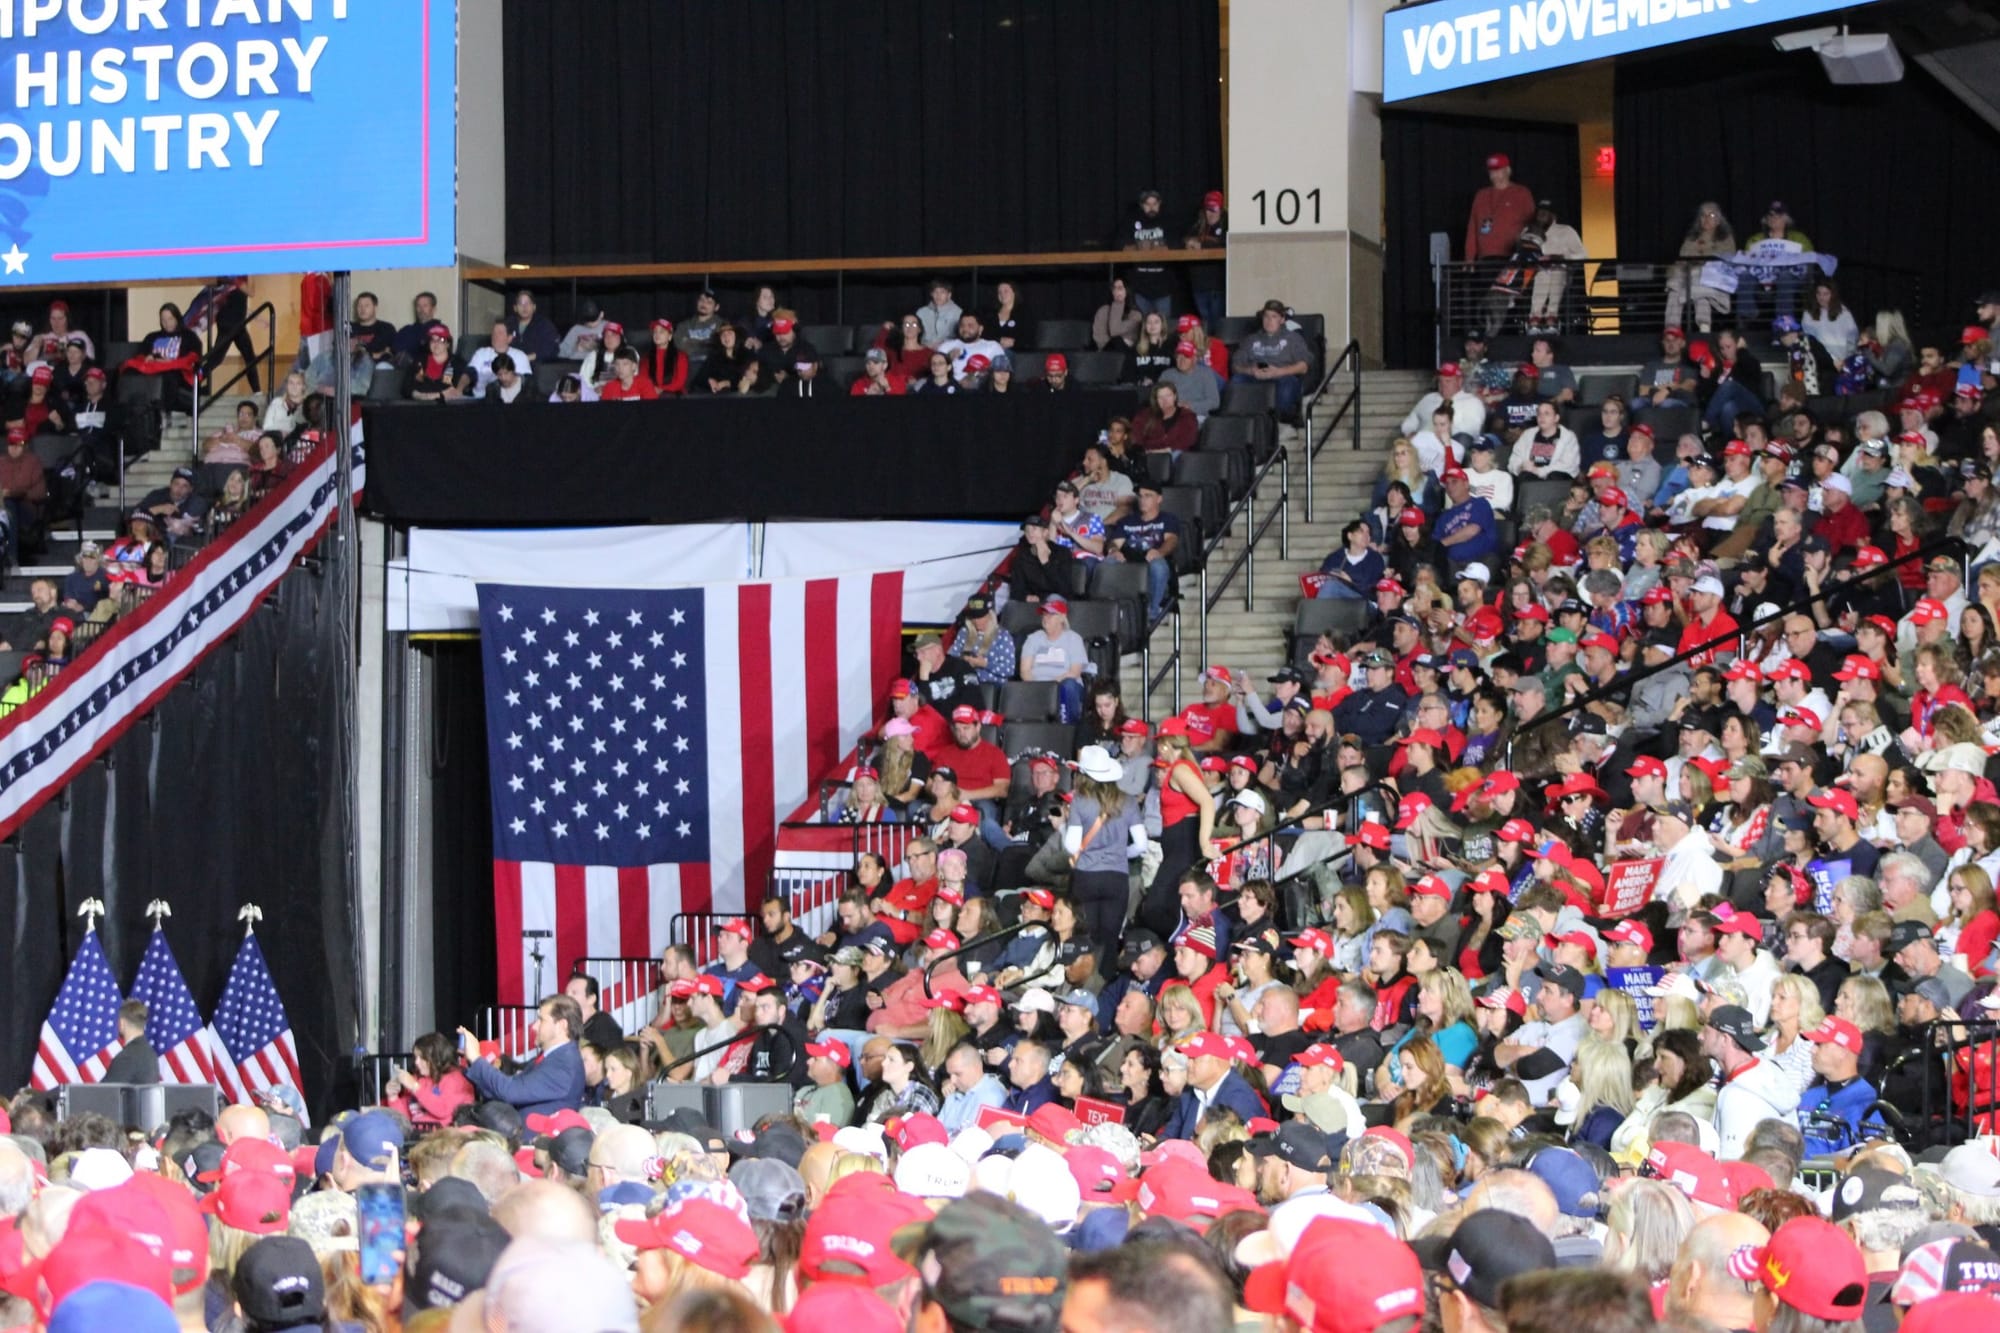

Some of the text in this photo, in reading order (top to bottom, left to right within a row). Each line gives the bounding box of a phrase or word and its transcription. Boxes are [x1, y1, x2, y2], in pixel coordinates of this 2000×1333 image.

[1402, 0, 1732, 76] VOTE NOVEMB
[15, 36, 329, 108] HISTORY
[1252, 188, 1320, 225] 101
[1624, 864, 1652, 877] MAKE
[1613, 874, 1654, 889] AMERICA
[1617, 884, 1648, 899] GREAT
[1623, 972, 1653, 986] MAKE
[1088, 1109, 1109, 1125] TEXT
[822, 1235, 875, 1257] TRUMP
[1958, 1262, 2000, 1280] TRU
